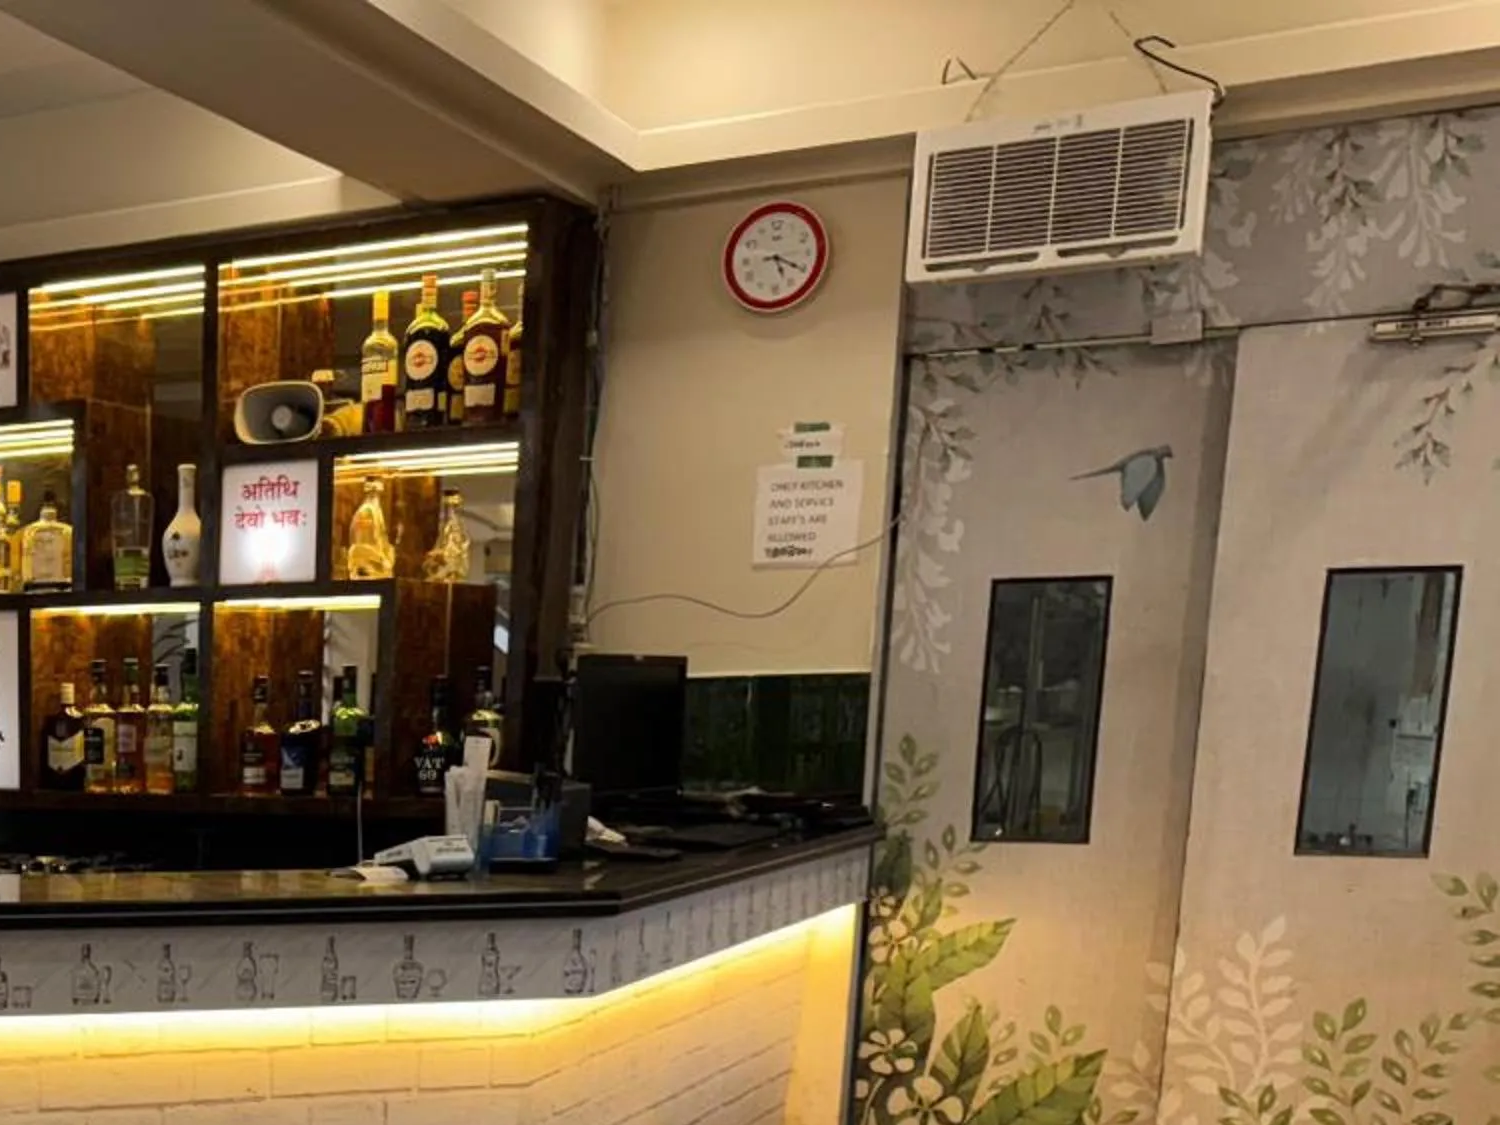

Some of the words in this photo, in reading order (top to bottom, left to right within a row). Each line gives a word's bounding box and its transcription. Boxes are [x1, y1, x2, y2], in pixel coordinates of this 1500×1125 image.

[800, 480, 844, 491] KITCHEN
[769, 498, 793, 509] AND
[808, 513, 827, 525] ARE
[767, 531, 817, 542] ALLOWED
